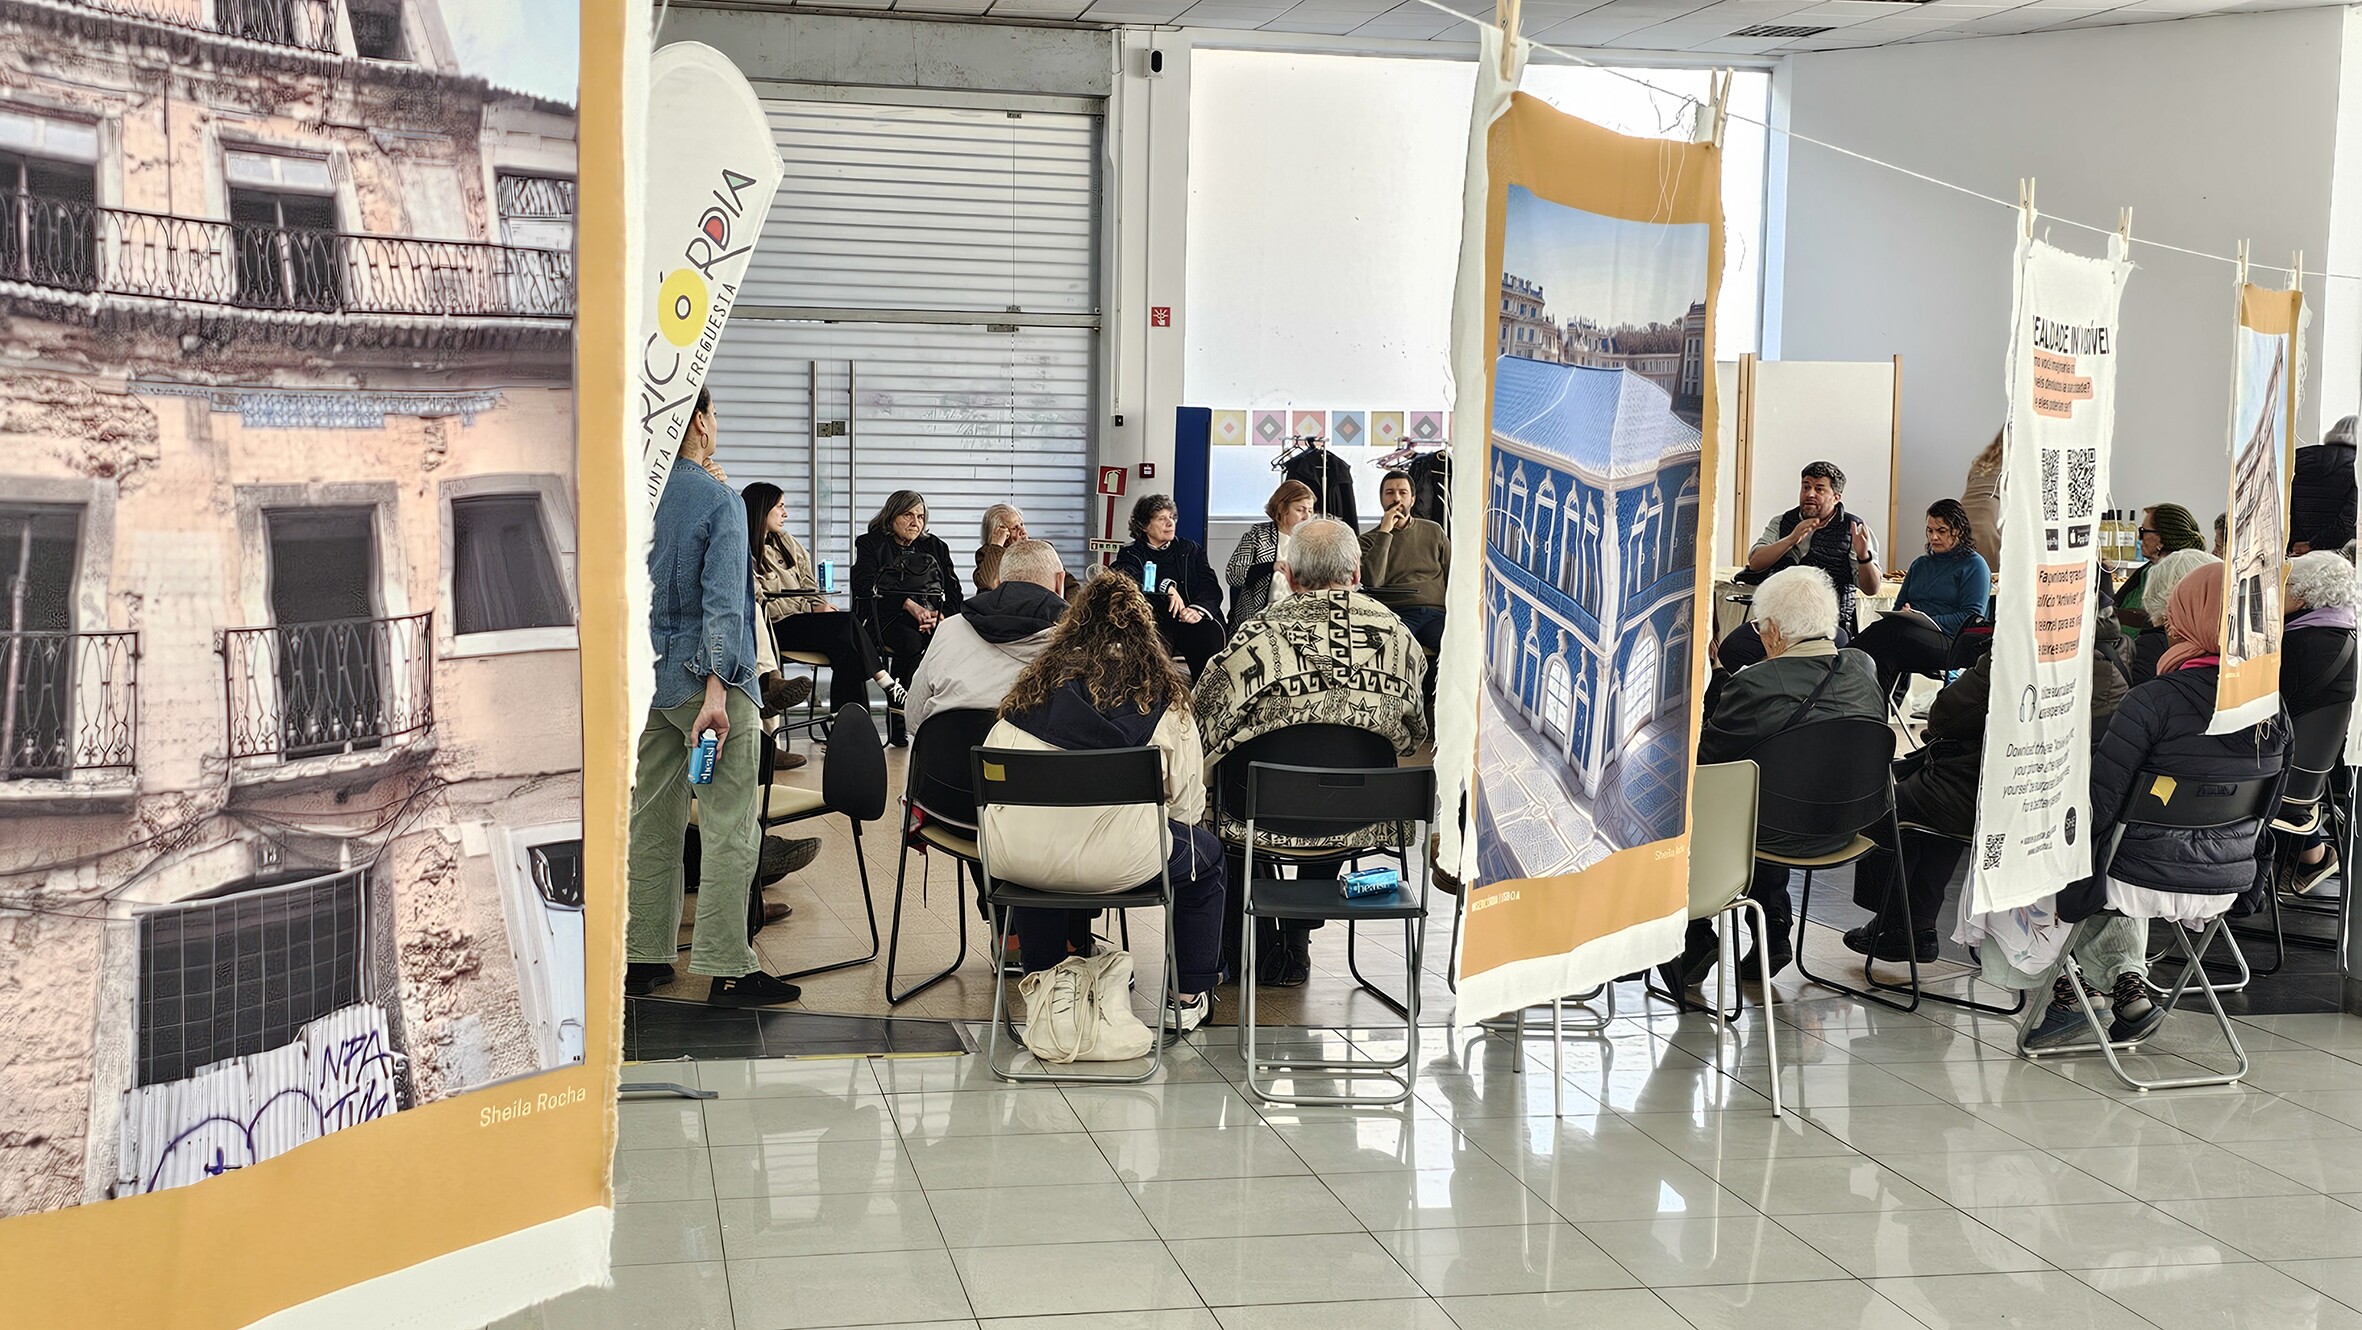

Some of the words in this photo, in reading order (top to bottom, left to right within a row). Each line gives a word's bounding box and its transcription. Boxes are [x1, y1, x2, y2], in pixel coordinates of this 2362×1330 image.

[666, 412, 684, 440] DE
[686, 282, 737, 387] FREGUESIA
[480, 1097, 532, 1127] Sheila
[537, 1085, 586, 1112] Rocha
